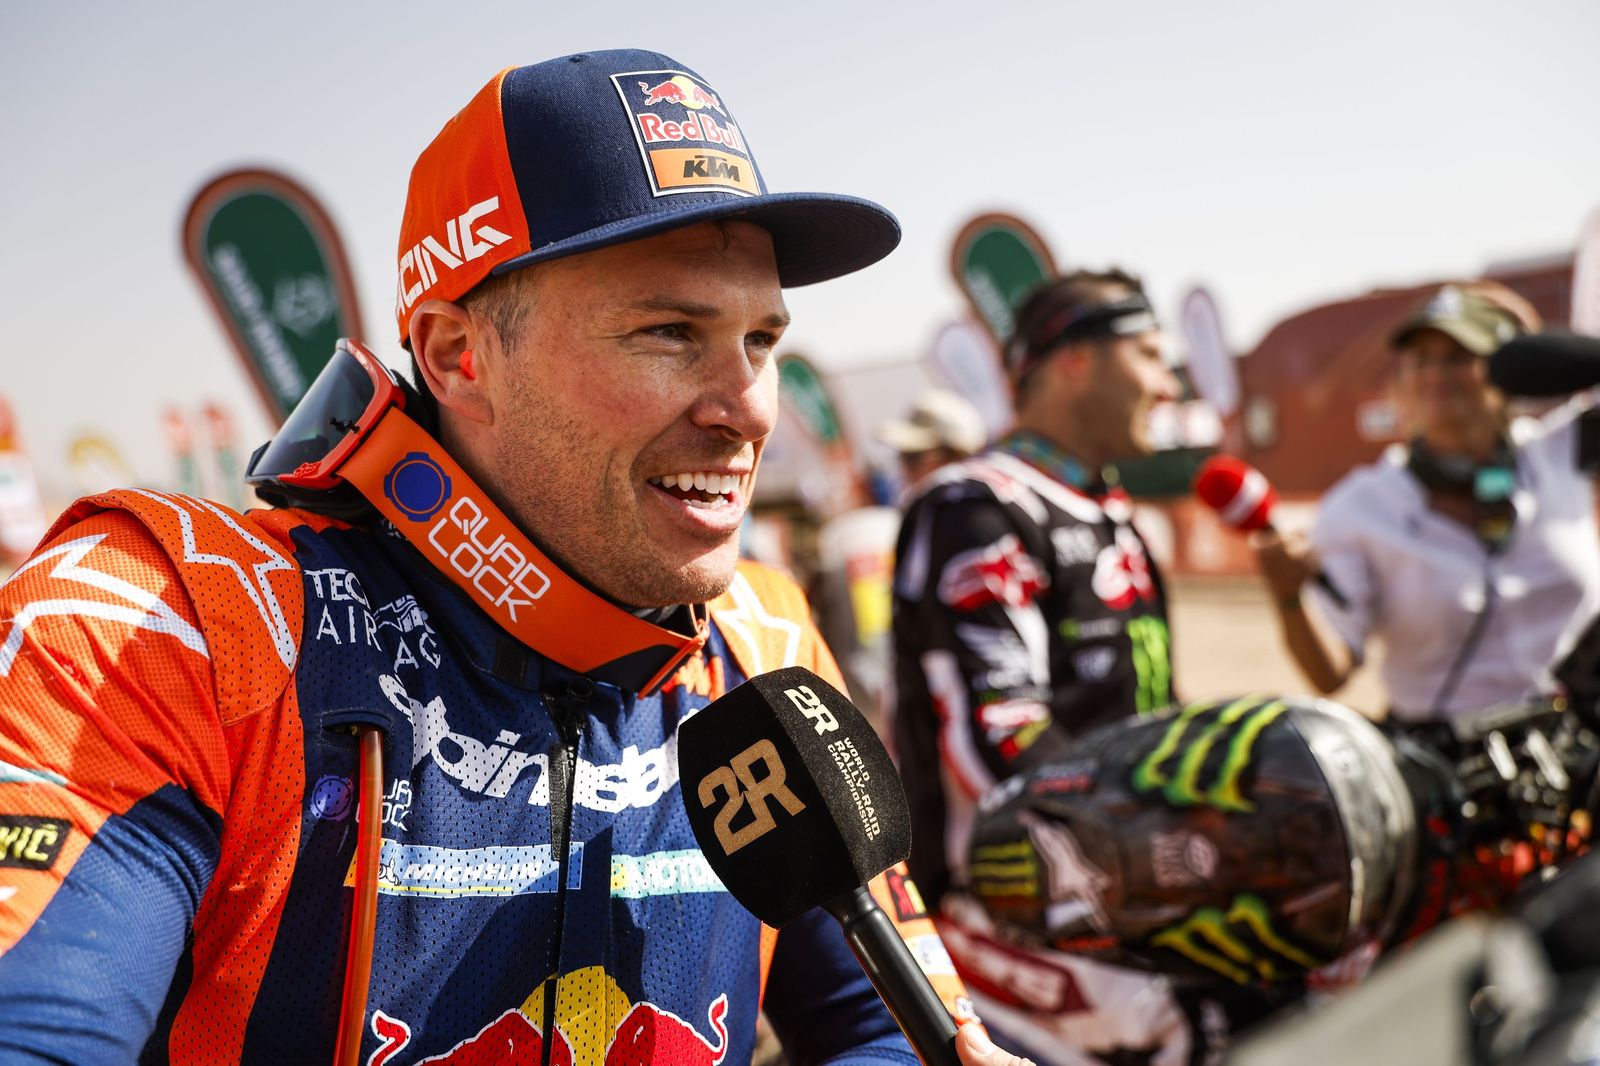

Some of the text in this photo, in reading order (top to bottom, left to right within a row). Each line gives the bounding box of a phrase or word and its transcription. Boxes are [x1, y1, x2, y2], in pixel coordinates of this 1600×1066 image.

[637, 111, 747, 155] Red Bull
[683, 155, 741, 182] KTM
[428, 517, 534, 624] LOCK
[450, 496, 551, 600] QUAD
[784, 685, 839, 736] 2R
[827, 744, 874, 842] CHAMPIONSHIP
[834, 740, 880, 836] RALLY-RAID
[843, 736, 870, 782] WORLD
[697, 738, 807, 856] 2R
[403, 860, 542, 883] MICHELIN
